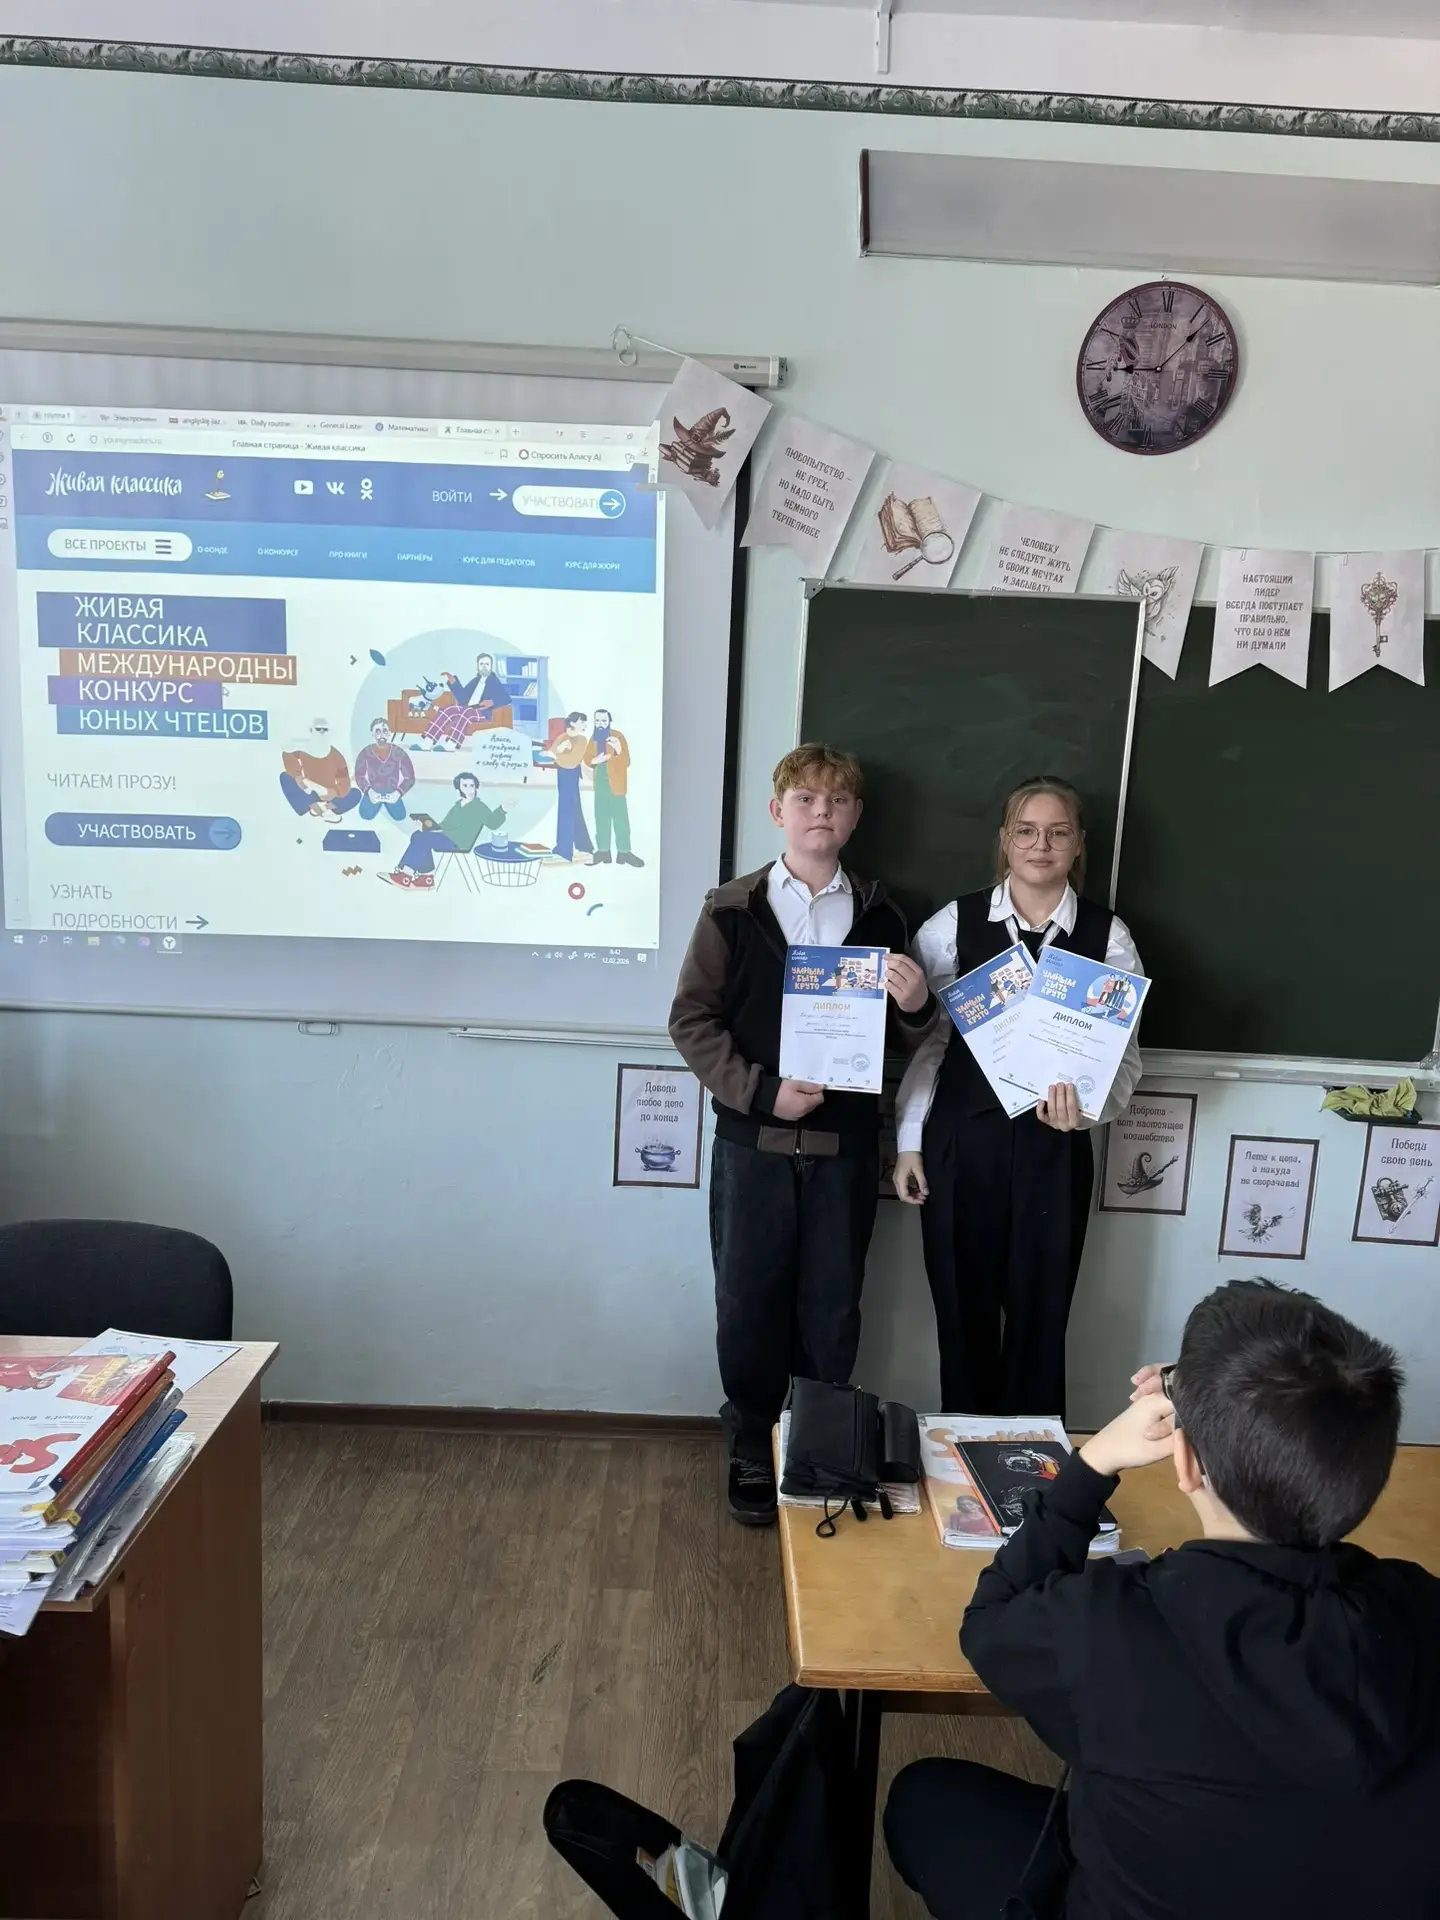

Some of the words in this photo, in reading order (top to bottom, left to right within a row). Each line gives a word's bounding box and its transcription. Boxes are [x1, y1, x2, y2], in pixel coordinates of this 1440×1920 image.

[1150, 322, 1178, 330] LONDON
[232, 440, 262, 448] Главная
[264, 441, 299, 450] страница
[304, 443, 330, 451] Живая
[531, 451, 567, 461] Спросить
[569, 453, 593, 461] Алису
[785, 447, 845, 480] ЛЮБОПЫТСТВО
[45, 467, 105, 496] Живая
[110, 474, 182, 496] классика
[795, 468, 807, 481] НЕ
[808, 475, 829, 492] ГРЕХ,
[432, 488, 473, 503] ВОЙТИ
[778, 478, 789, 490] НО
[790, 484, 811, 501] НАДО
[812, 492, 835, 512] БЫТЬ
[783, 498, 819, 521] НЕМНОГО
[772, 509, 821, 539] ТЕРПЕЛИВЕЕ
[64, 538, 87, 550] ВСЕ
[90, 539, 146, 552] ПРОЕКТЫ
[263, 548, 298, 556] КОНКУРСЕ
[1020, 536, 1060, 554] ЧЕЛОВЕКУ
[344, 551, 367, 559] КНИГИ
[462, 556, 480, 564] КУРС
[480, 557, 496, 565] ДЛЯ
[496, 558, 536, 567] ПЕДАГОГОВ
[999, 545, 1009, 556] НЕ
[1010, 549, 1046, 564] СЛЕДУЕТ
[1047, 558, 1071, 572] ЖИТЬ
[565, 561, 582, 569] КУРС
[582, 562, 597, 570] ДЛЯ
[597, 563, 620, 571] ЖЮРИ
[998, 560, 1004, 568] В
[1005, 561, 1030, 575] СВОИХ
[1031, 568, 1065, 583] МЕЧТАХ
[1002, 575, 1009, 584] И
[1010, 576, 1052, 592] ЗАБЫВАТЬ
[1254, 588, 1280, 598] ЛИДЕР
[74, 596, 164, 619] ЖИВАЯ
[1225, 601, 1256, 611] ВСЕГДА
[1259, 601, 1304, 611] ПОСТУПАЕТ
[77, 622, 208, 647] КЛАССИКА
[1235, 627, 1251, 636] ЧТО
[1253, 628, 1265, 636] БЫ
[1267, 628, 1272, 636] О
[1274, 628, 1291, 637] НЕМ
[1236, 641, 1248, 649] НИ
[1251, 641, 1286, 651] ДУМАЛИ
[78, 652, 294, 683] МЕЖДУНАРОДНЫ
[79, 679, 194, 704] КОНКУРС
[79, 708, 159, 731] ЮНЫХ
[164, 711, 264, 738] ЧТЕЦОВ
[47, 773, 113, 789] ЧИТАЕМ
[117, 774, 177, 791] ПРОЗУ!
[78, 823, 196, 840] УЧАСТВОВАТЬ
[50, 884, 113, 900] УЗНАТЬ
[52, 913, 178, 931] ПОДРОБНОСТИ
[791, 967, 824, 976] УМНЫМ
[1042, 969, 1077, 988] УМНЫМ
[794, 982, 820, 990] КРУТО
[796, 975, 819, 983] БЫТЬ
[1045, 979, 1068, 993] БЫТЬ
[1041, 987, 1067, 1001] КРУТО
[813, 1002, 851, 1011] ДИПЛОМ
[964, 1002, 985, 1018] БЫТЬ
[967, 1008, 989, 1026] КРУТО
[993, 1012, 1021, 1034] ДИПЛО
[1053, 1011, 1093, 1031] ДИПЛОМ
[645, 1081, 677, 1094] Доводи
[636, 1097, 662, 1107] любое
[664, 1100, 684, 1109] дело
[1129, 1104, 1166, 1117] Доброта
[640, 1113, 651, 1122] до
[653, 1114, 679, 1123] конца
[1116, 1119, 1133, 1127] вот
[1136, 1121, 1184, 1131] настоящее
[1123, 1132, 1175, 1143] волшебство
[1391, 1137, 1427, 1152] Победи
[1244, 1150, 1268, 1160] Лети
[1380, 1156, 1407, 1165] свою
[1409, 1158, 1433, 1167] лень
[1260, 1167, 1291, 1176] никуда
[1252, 1179, 1300, 1188] сворачивай
